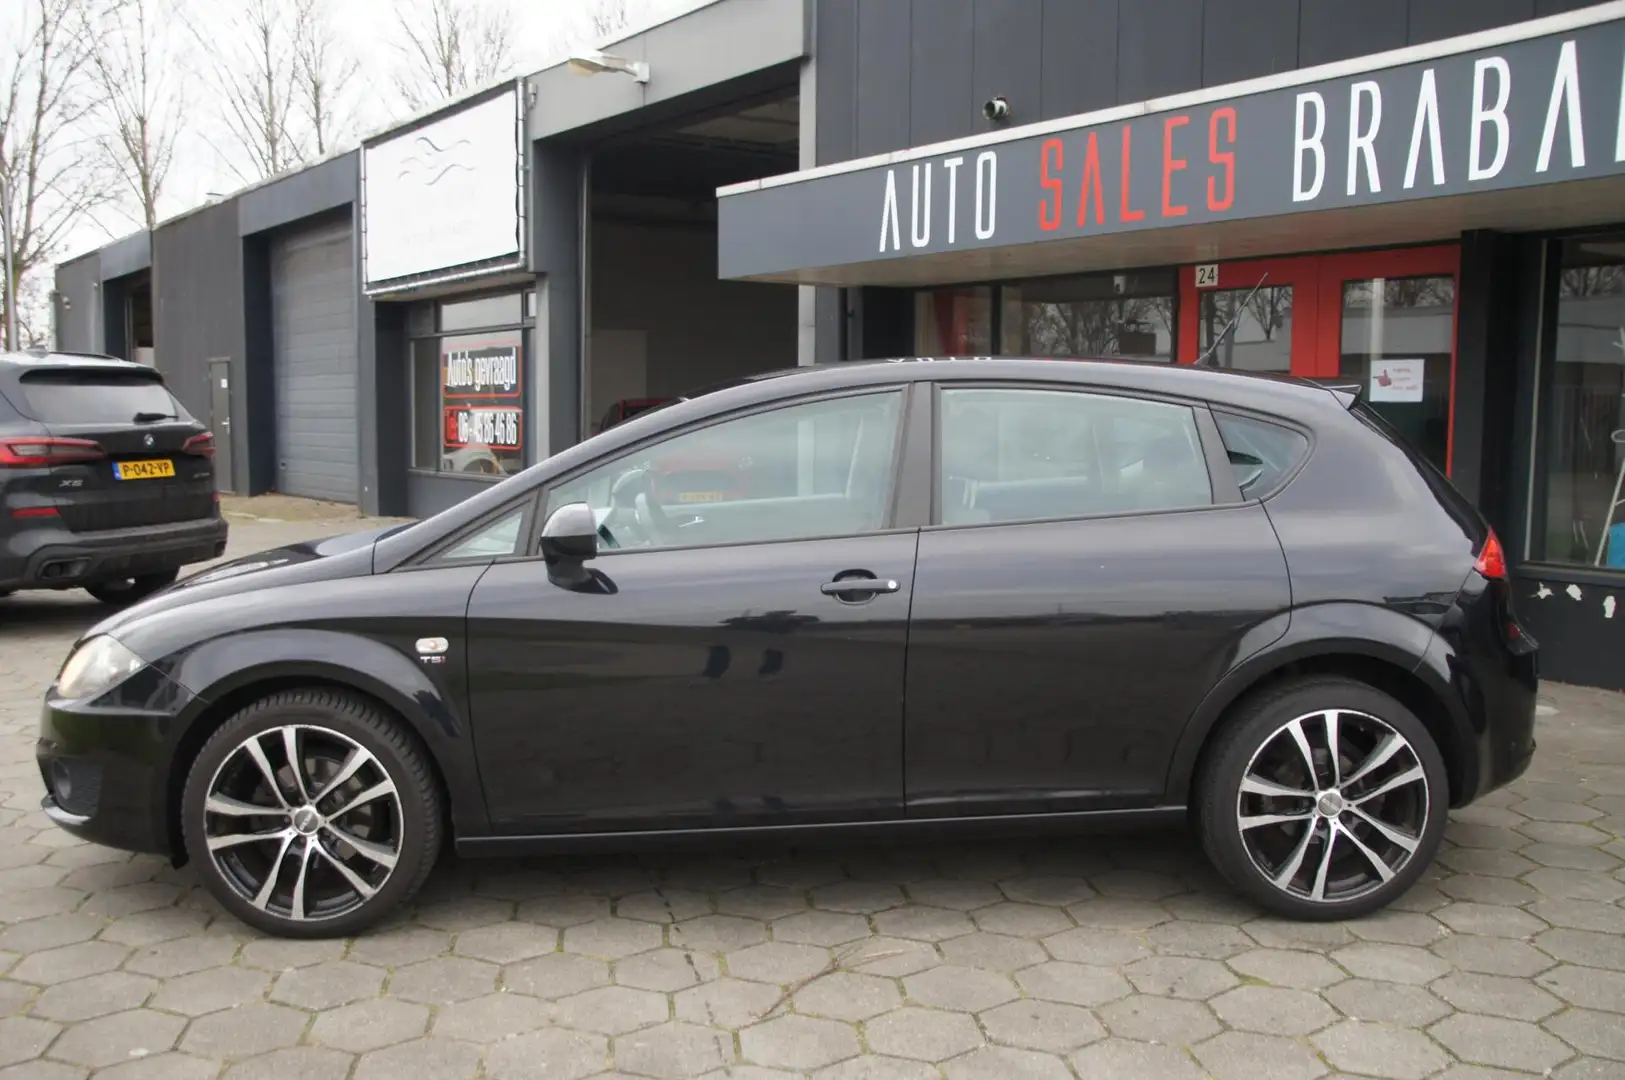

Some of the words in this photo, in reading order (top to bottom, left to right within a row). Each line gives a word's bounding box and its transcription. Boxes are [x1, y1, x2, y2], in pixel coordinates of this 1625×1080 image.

[879, 151, 997, 252] AUTO
[1038, 107, 1236, 231] SALES
[1292, 40, 1625, 202] BRABA
[1198, 267, 1216, 285] 24
[447, 350, 473, 387] Auto's
[474, 346, 517, 391] gevraagd
[122, 462, 170, 476] P-042-VP
